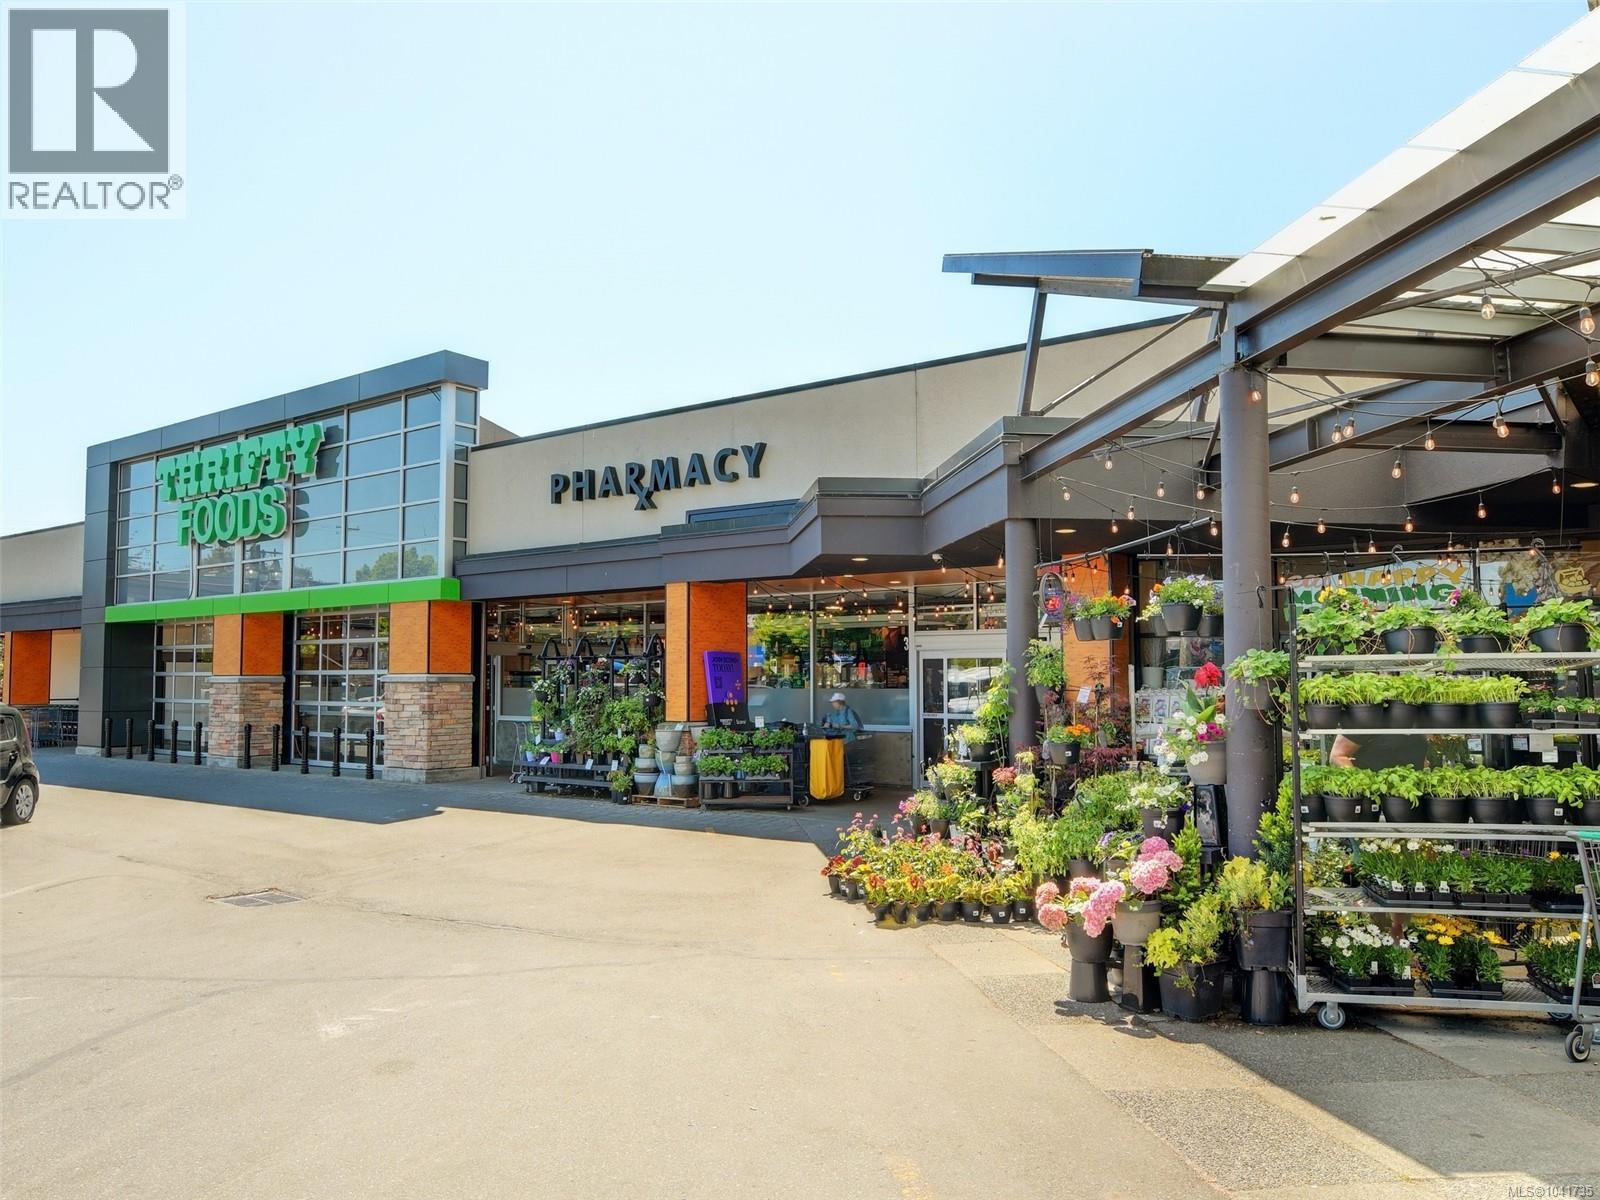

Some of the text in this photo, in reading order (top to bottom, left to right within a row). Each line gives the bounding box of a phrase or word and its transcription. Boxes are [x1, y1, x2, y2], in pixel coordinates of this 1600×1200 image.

[156, 422, 325, 503] THRIFTY
[551, 442, 767, 504] PHARMACY
[178, 485, 287, 547] FOODS
[1342, 566, 1468, 587] HAPPY
